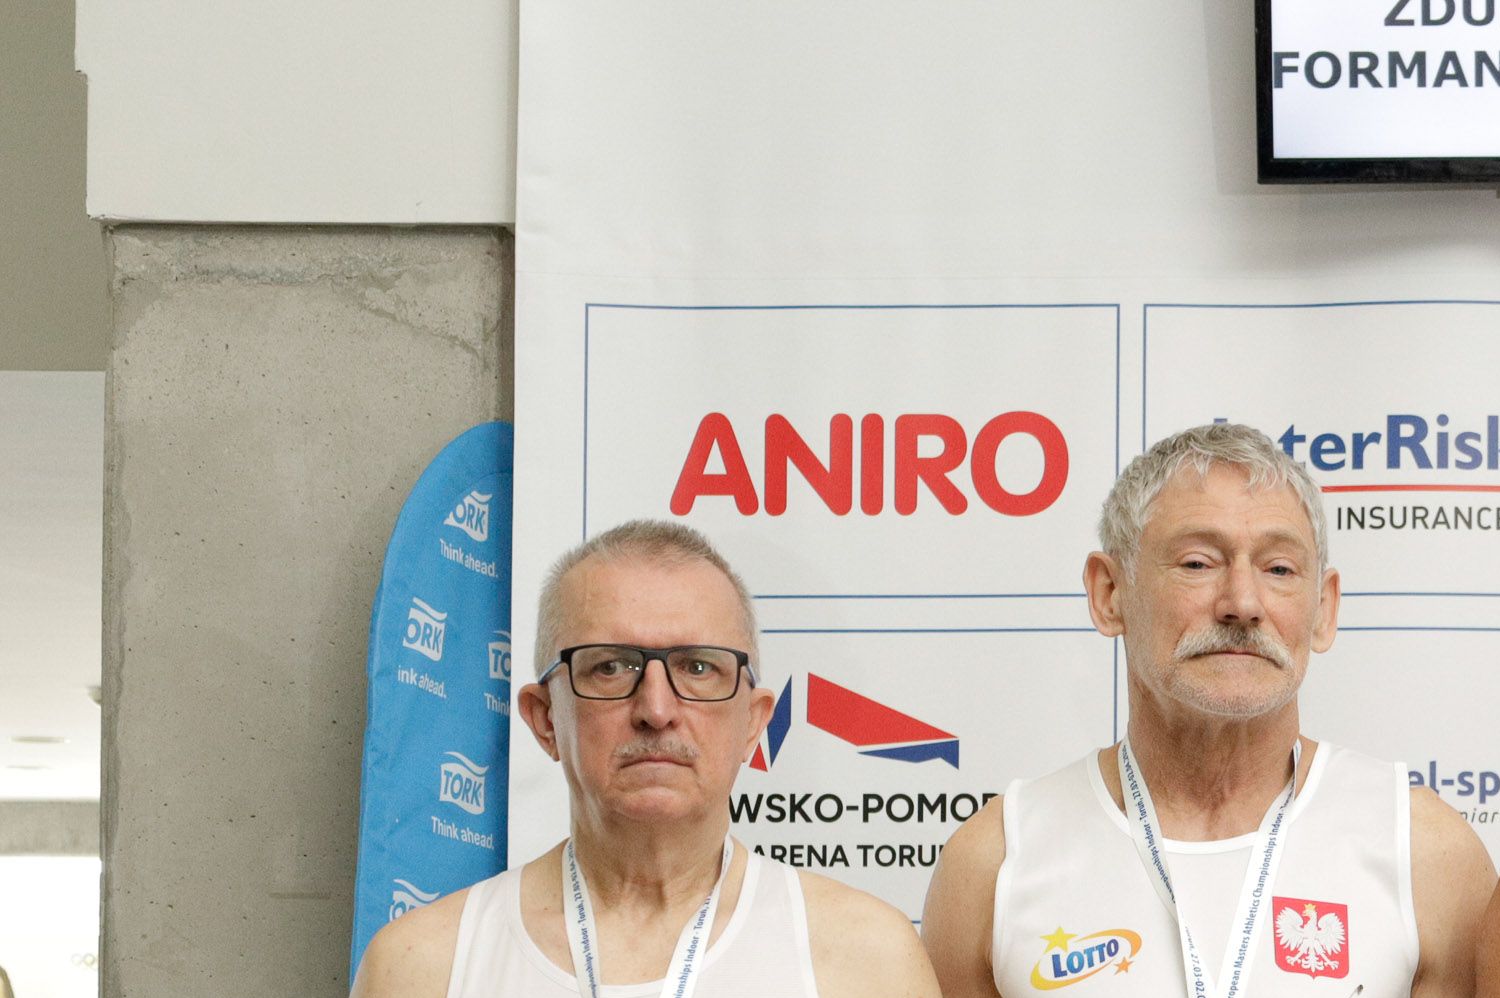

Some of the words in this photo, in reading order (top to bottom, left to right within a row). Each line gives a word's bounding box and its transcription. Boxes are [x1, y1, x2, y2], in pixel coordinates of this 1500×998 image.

[670, 411, 1069, 516] ANIRO
[440, 538, 464, 565] Think
[464, 551, 499, 578] ahead.
[418, 673, 447, 699] ahead.
[443, 769, 482, 807] TORK
[431, 815, 459, 841] Think
[461, 827, 494, 850] ahead.
[1233, 936, 1250, 971] Masters
[1243, 900, 1260, 936] Athletics
[1253, 833, 1277, 899] Championships
[685, 933, 699, 963] Indoor
[1052, 939, 1119, 978] LOTTO
